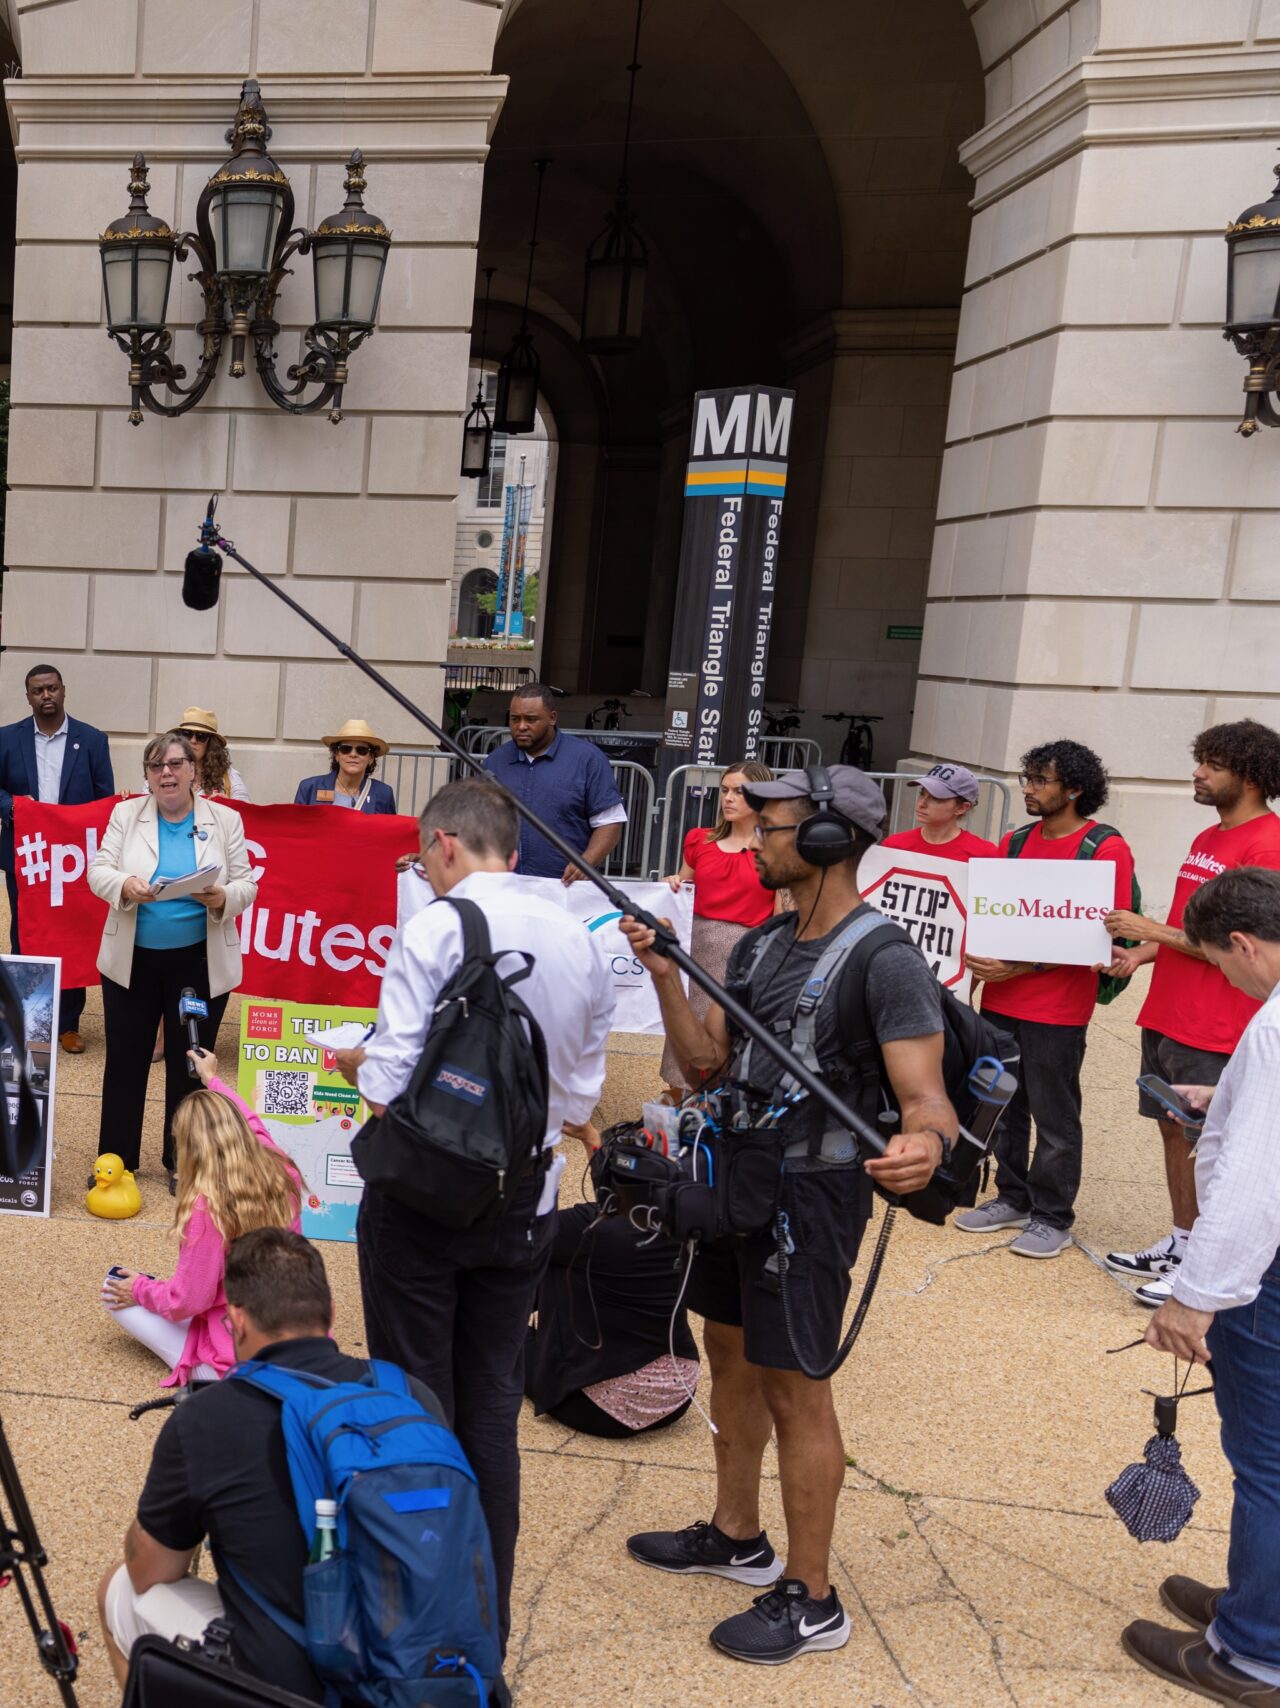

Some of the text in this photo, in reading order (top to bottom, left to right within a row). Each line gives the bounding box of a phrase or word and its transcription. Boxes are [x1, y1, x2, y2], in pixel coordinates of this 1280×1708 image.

[693, 394, 751, 456] M
[752, 393, 793, 457] M
[715, 497, 743, 590] Federal
[761, 499, 783, 591] Federal
[702, 601, 731, 697] Triangle
[751, 602, 773, 697] Triangle
[880, 881, 950, 918] STOP
[973, 896, 1111, 921] EcoMadres
[243, 1044, 270, 1061] TO
[275, 1046, 318, 1064] BAN
